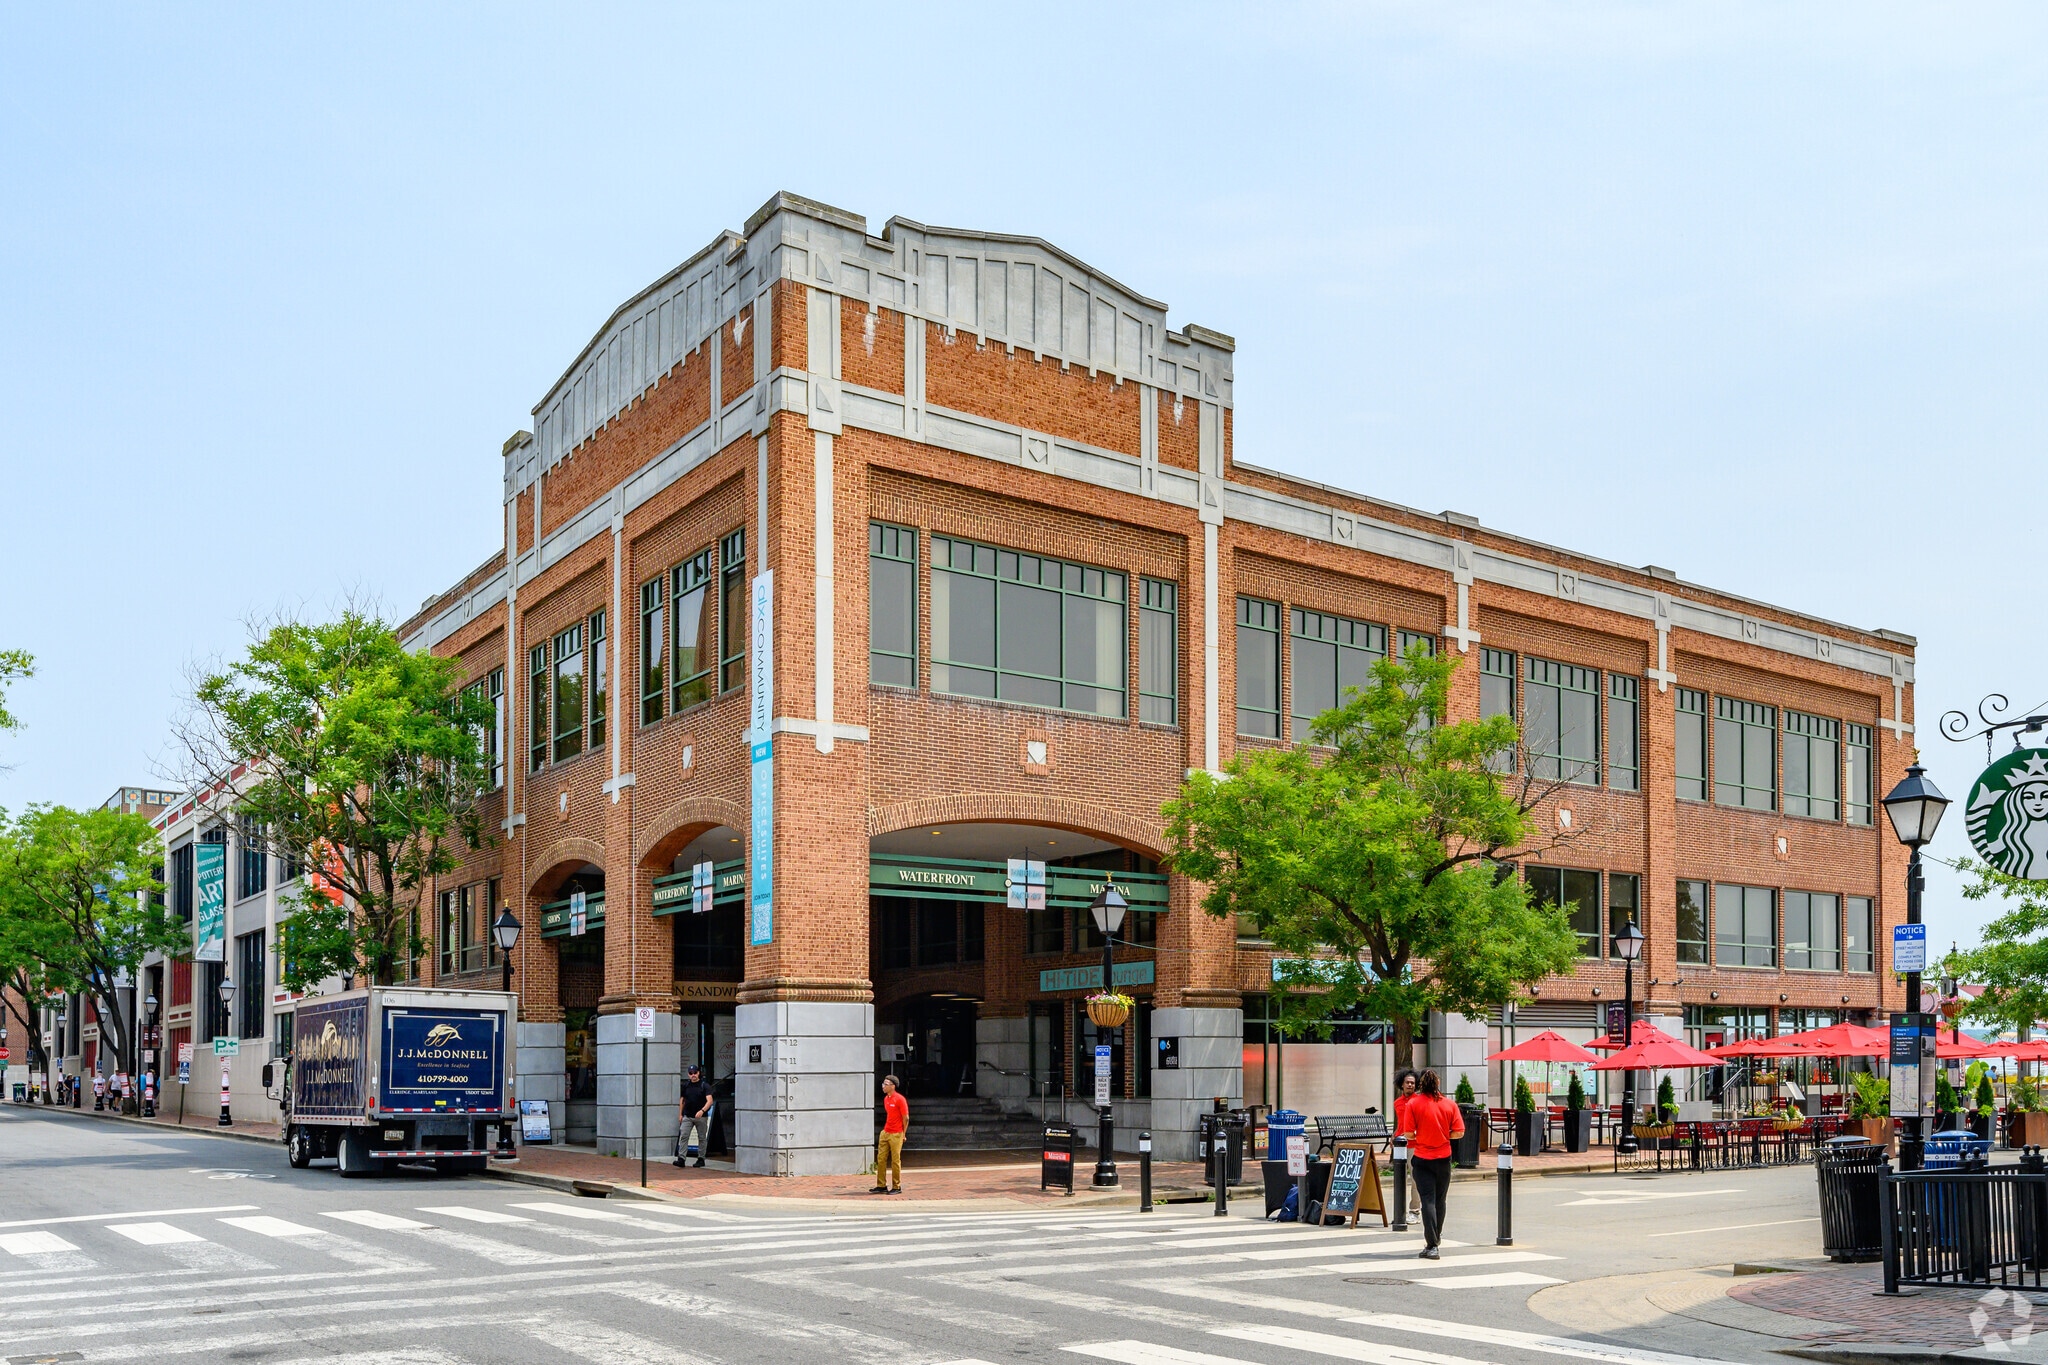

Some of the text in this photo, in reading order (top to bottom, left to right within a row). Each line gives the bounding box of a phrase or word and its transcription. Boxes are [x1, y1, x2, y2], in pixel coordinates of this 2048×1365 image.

[755, 747, 766, 758] NEW
[198, 864, 224, 880] POTTERY
[899, 870, 1130, 895] WATERFRONT MAINA
[198, 880, 224, 906] ART
[654, 886, 688, 901] WATERFRONT
[199, 904, 224, 922] GLASS
[547, 914, 560, 924] SHOPS
[1046, 967, 1100, 988] HI-TIDE
[688, 986, 741, 996] SANDWI
[398, 1049, 488, 1059] J.J.McDONNELL
[1339, 1149, 1364, 1164] SHOP
[1334, 1164, 1361, 1179] LOCAL
